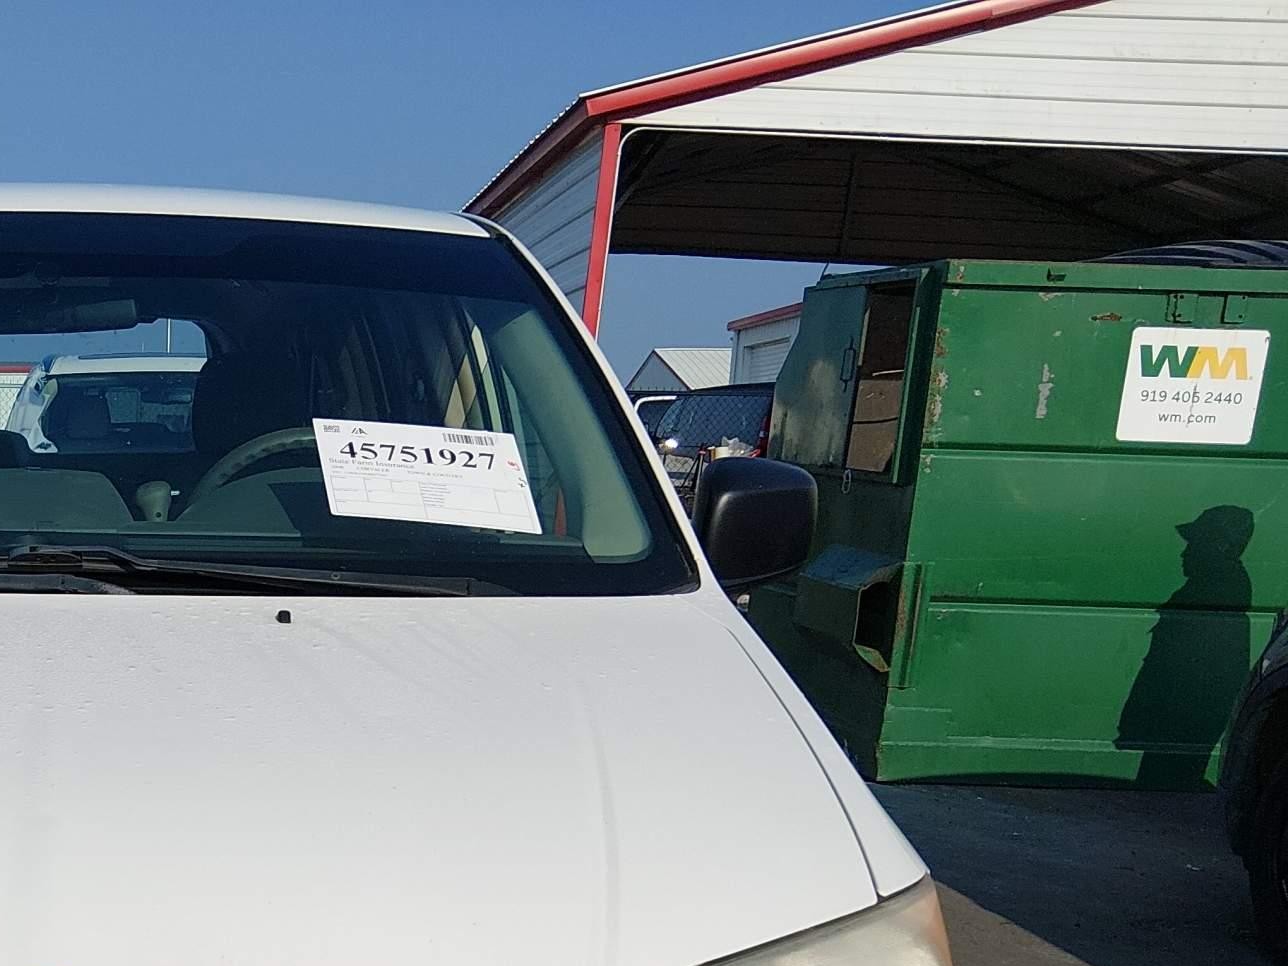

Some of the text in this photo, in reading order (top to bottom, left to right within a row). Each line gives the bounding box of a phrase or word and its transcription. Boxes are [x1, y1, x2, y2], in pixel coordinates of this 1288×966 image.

[1140, 345, 1248, 380] WM
[1140, 390, 1168, 403] 919
[1204, 392, 1243, 405] 2440
[1158, 413, 1217, 424] wm.com
[339, 441, 495, 470] 45751927
